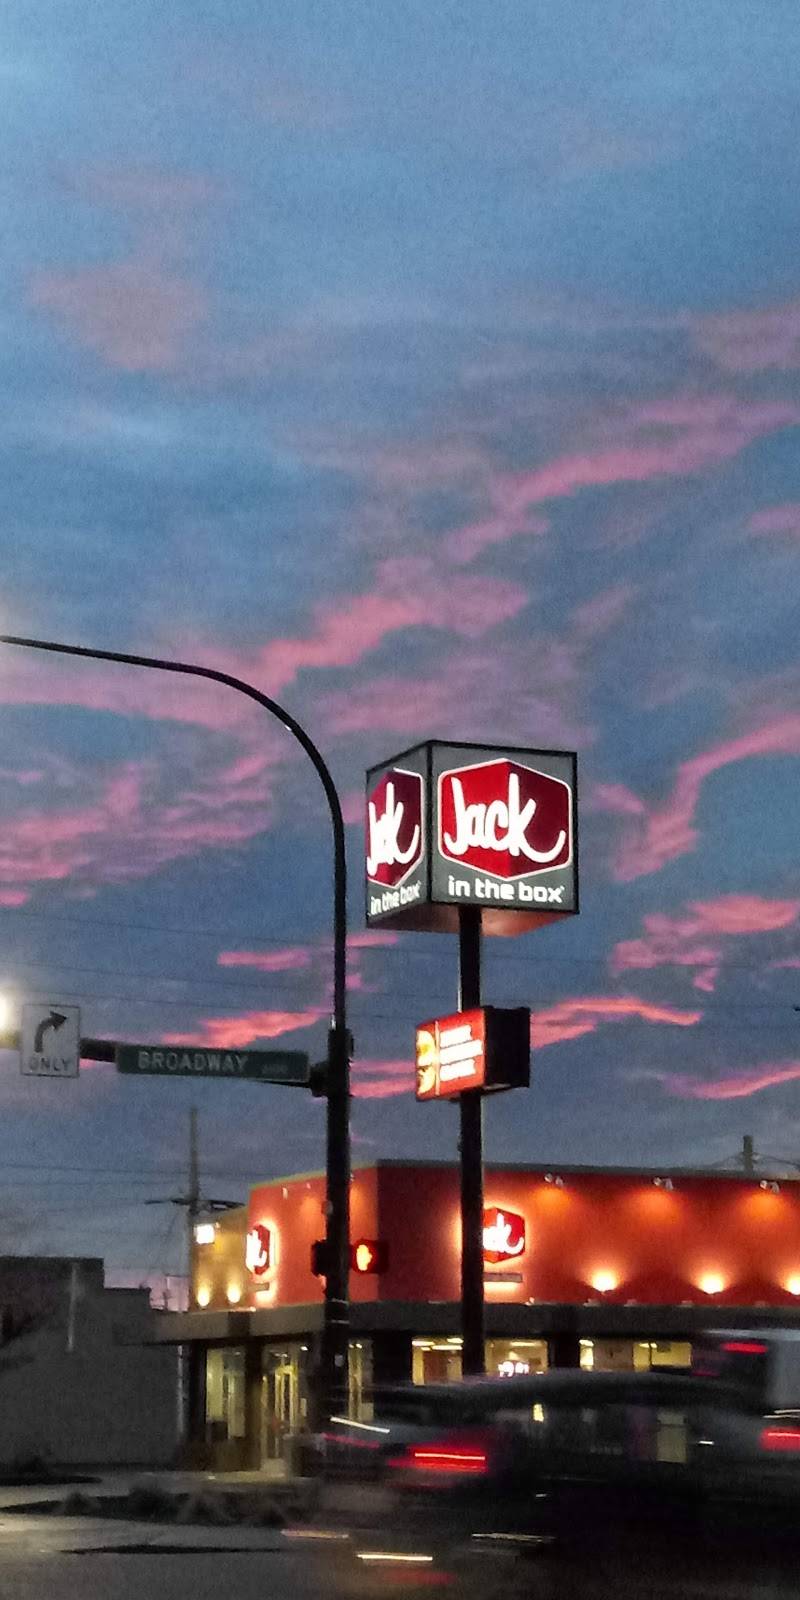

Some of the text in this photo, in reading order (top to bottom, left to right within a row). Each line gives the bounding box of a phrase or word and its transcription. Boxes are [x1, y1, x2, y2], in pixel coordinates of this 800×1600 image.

[443, 772, 567, 863] Jack
[370, 885, 420, 915] in the box
[448, 875, 563, 903] in the box
[30, 1056, 73, 1072] ONLY
[137, 1051, 249, 1072] BROADWAY
